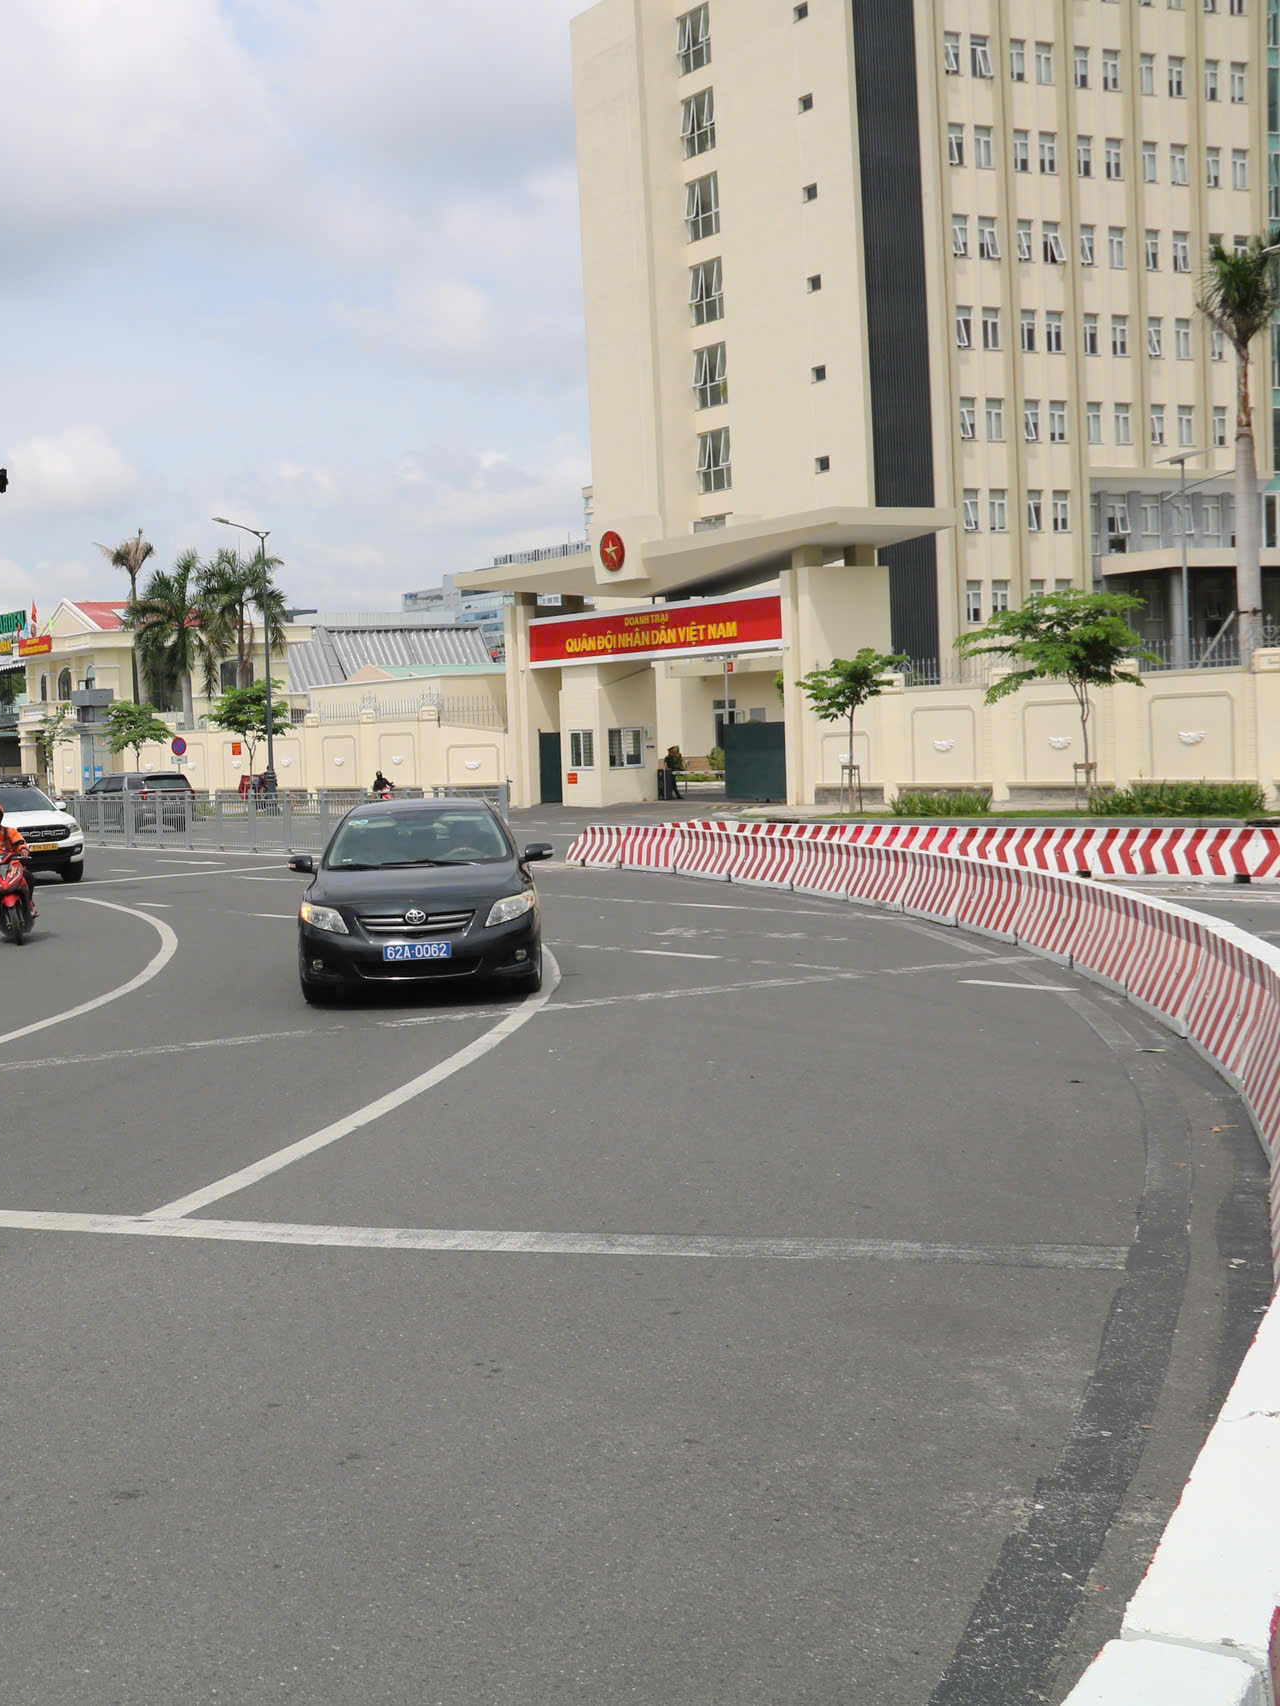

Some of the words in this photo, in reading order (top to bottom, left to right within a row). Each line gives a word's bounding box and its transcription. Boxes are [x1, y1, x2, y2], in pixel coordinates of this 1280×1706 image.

[624, 615, 650, 627] DOANH
[651, 613, 669, 626] TRẠI
[565, 633, 596, 653] QUÂN
[597, 630, 617, 652] ĐỘI
[618, 628, 651, 649] NHÂN
[651, 625, 677, 645] DÂN
[678, 622, 705, 645] VIỆT
[707, 621, 737, 640] NAM
[19, 829, 66, 838] FORD
[387, 944, 448, 959] 62A-0062
